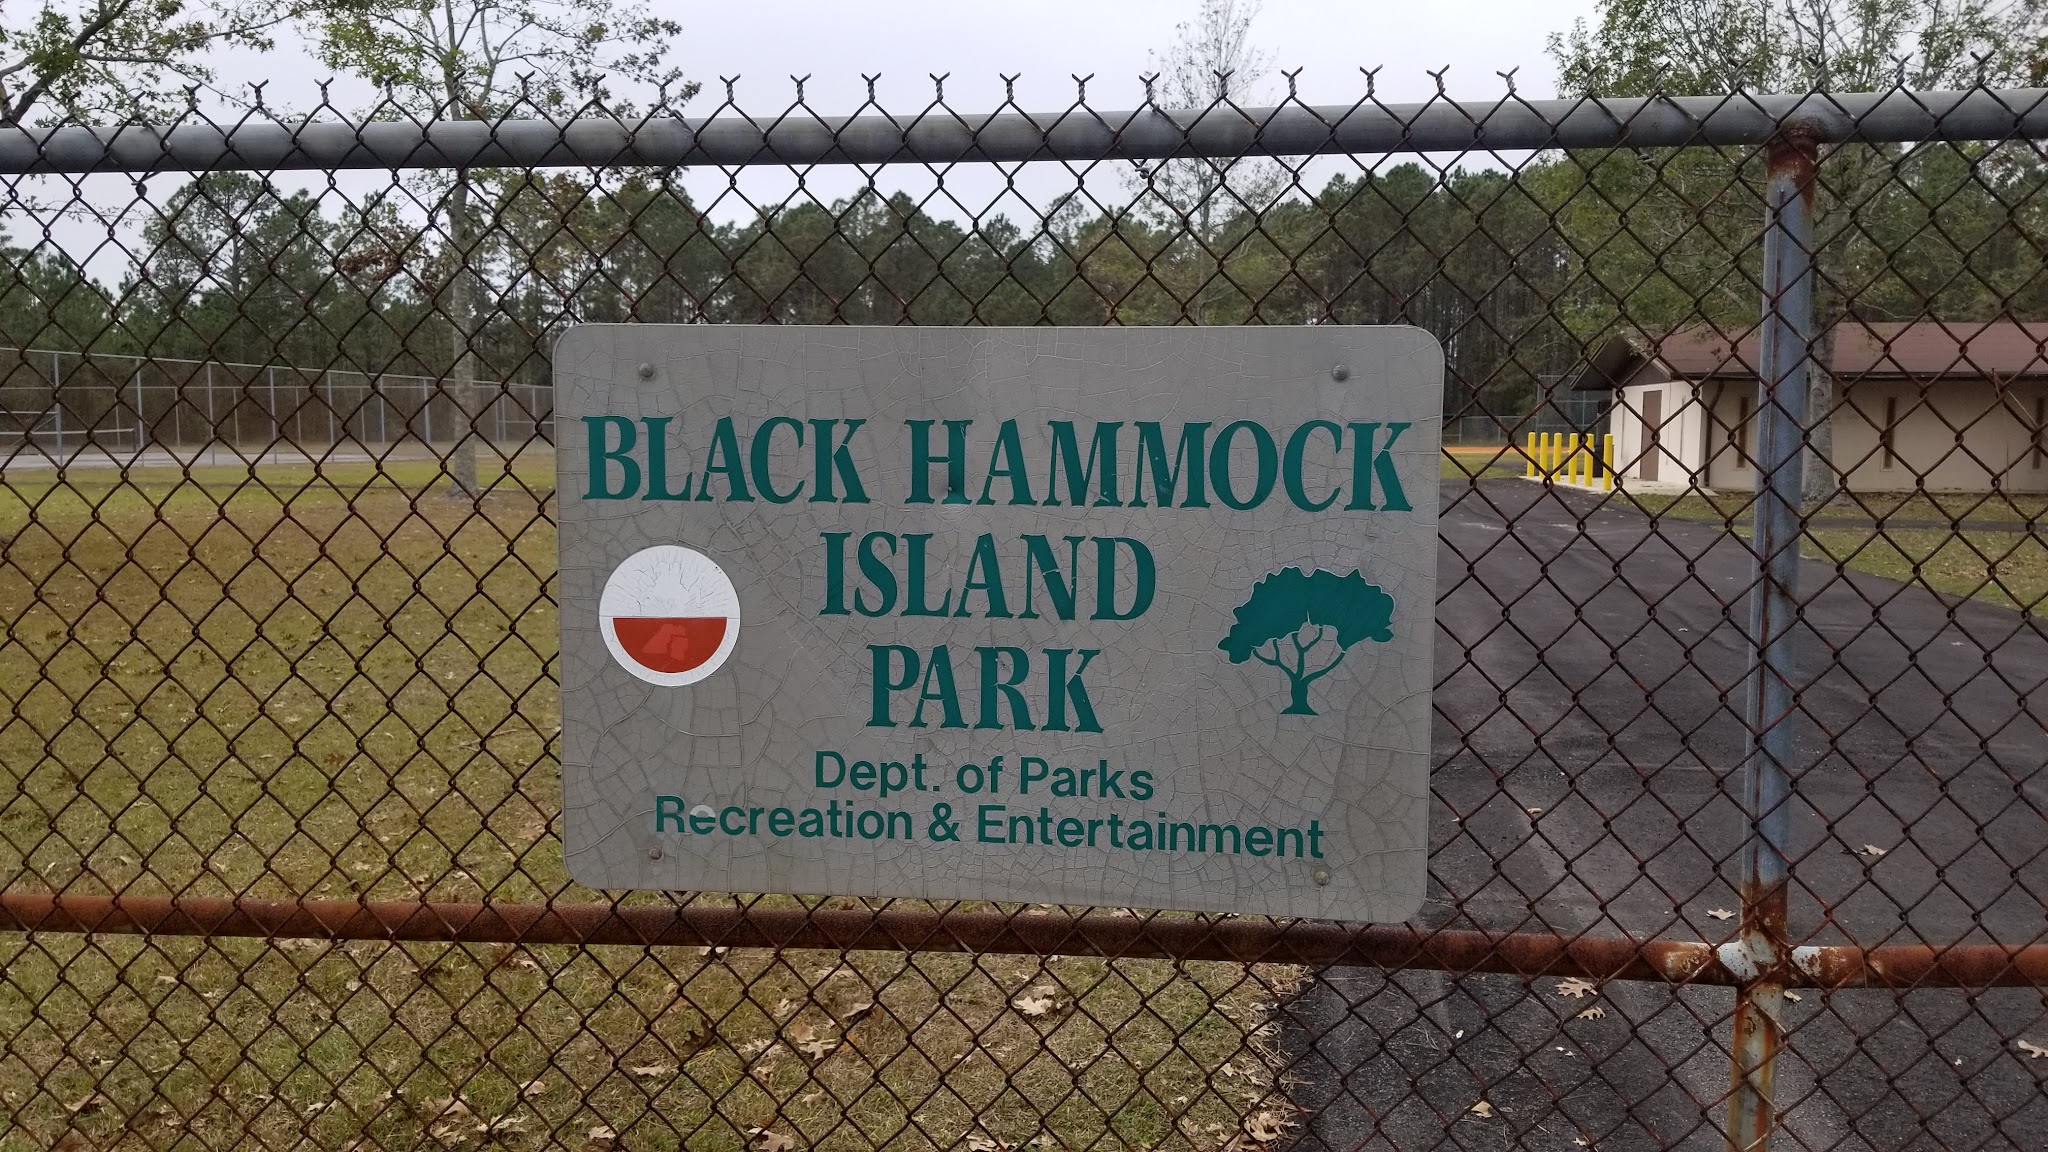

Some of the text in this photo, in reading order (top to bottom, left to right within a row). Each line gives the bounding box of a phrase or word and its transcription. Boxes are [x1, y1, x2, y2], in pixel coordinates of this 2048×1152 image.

[582, 415, 1414, 513] BLACK HAMMOCK
[819, 530, 1157, 621] ISLAND
[866, 644, 1104, 734] PARK
[815, 750, 1153, 801] Dept. of Parks
[655, 794, 1324, 859] Recreation & Entertainment
